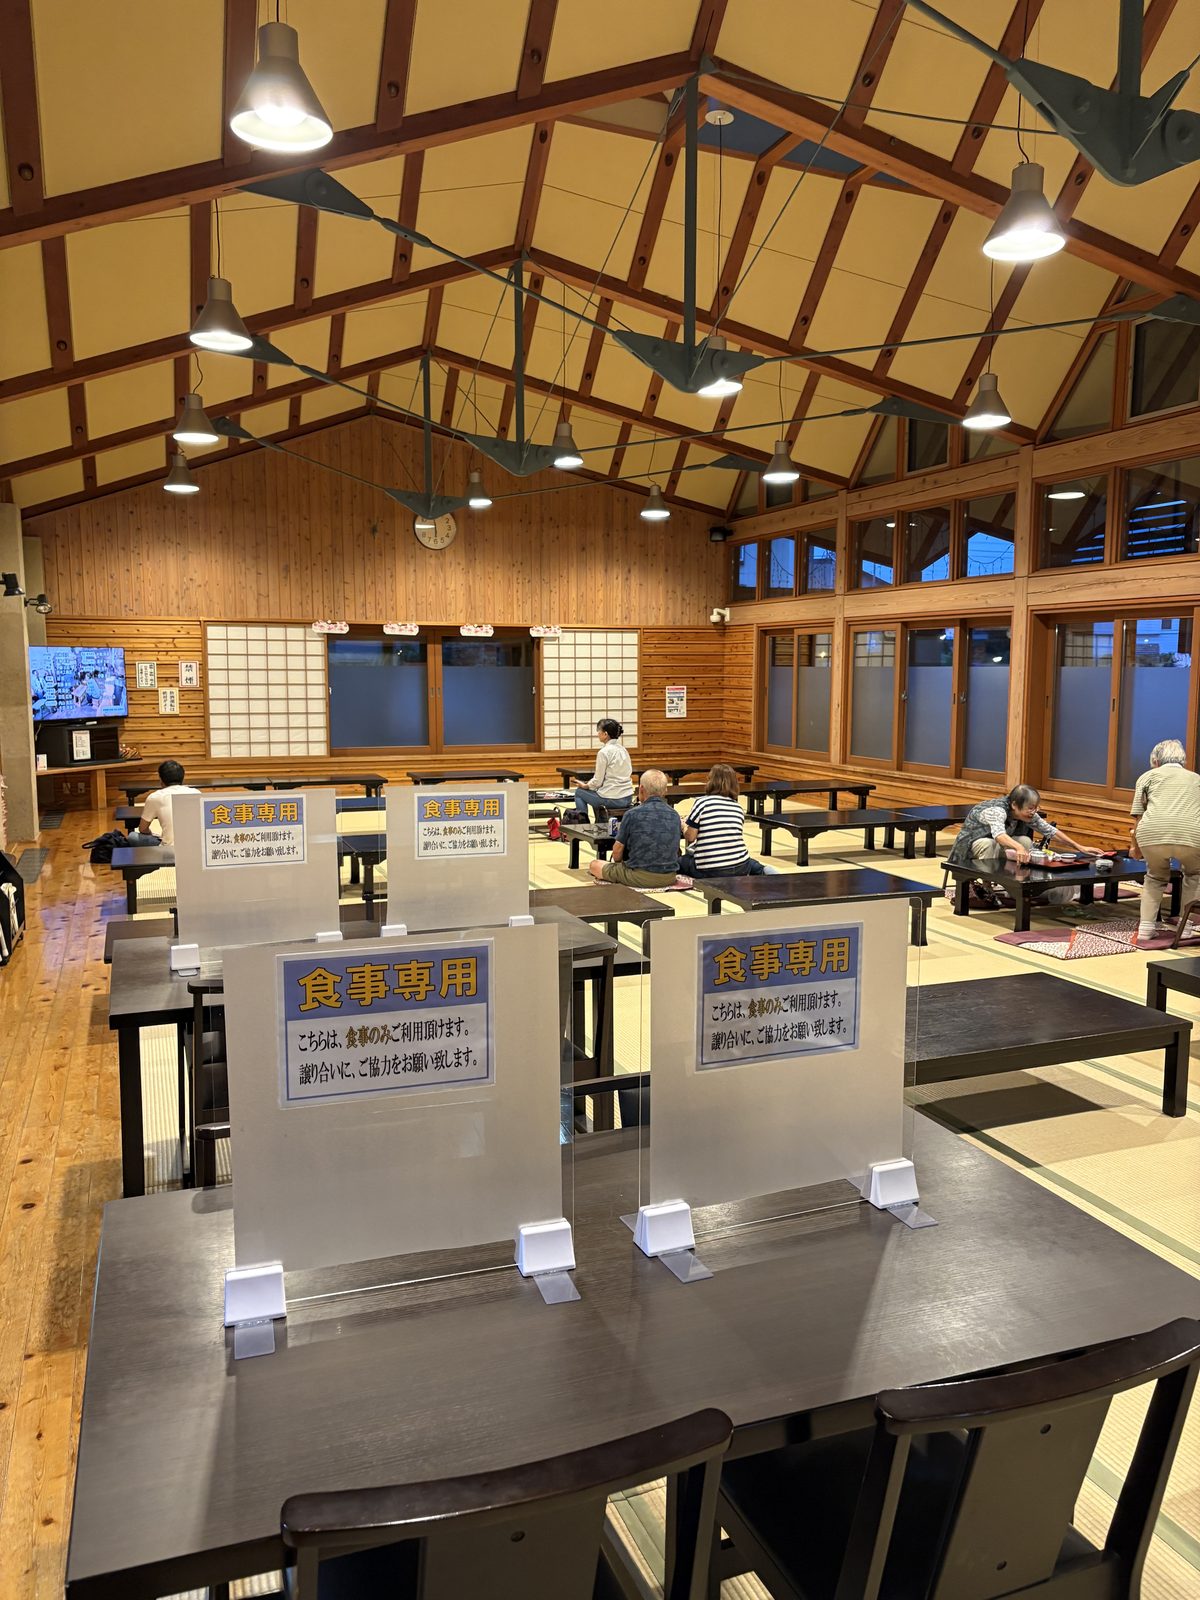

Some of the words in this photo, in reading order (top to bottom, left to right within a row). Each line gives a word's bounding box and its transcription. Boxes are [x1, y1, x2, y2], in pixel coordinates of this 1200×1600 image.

[185, 664, 194, 684] 禁煙
[210, 802, 298, 825] 食事専用
[423, 799, 500, 819] 食事専用
[713, 936, 850, 986] 食事専用
[297, 956, 478, 1012] 食事専用
[711, 990, 842, 1022] こちらは、食事のみご利用頂けます。
[298, 1016, 469, 1051] こちらは、食事のみご利用頂けます。
[711, 1016, 847, 1051] 譲り合いに、ご協力をお願い致します。
[299, 1047, 478, 1086] 譲り合いに、ご協力をお願い致します。
